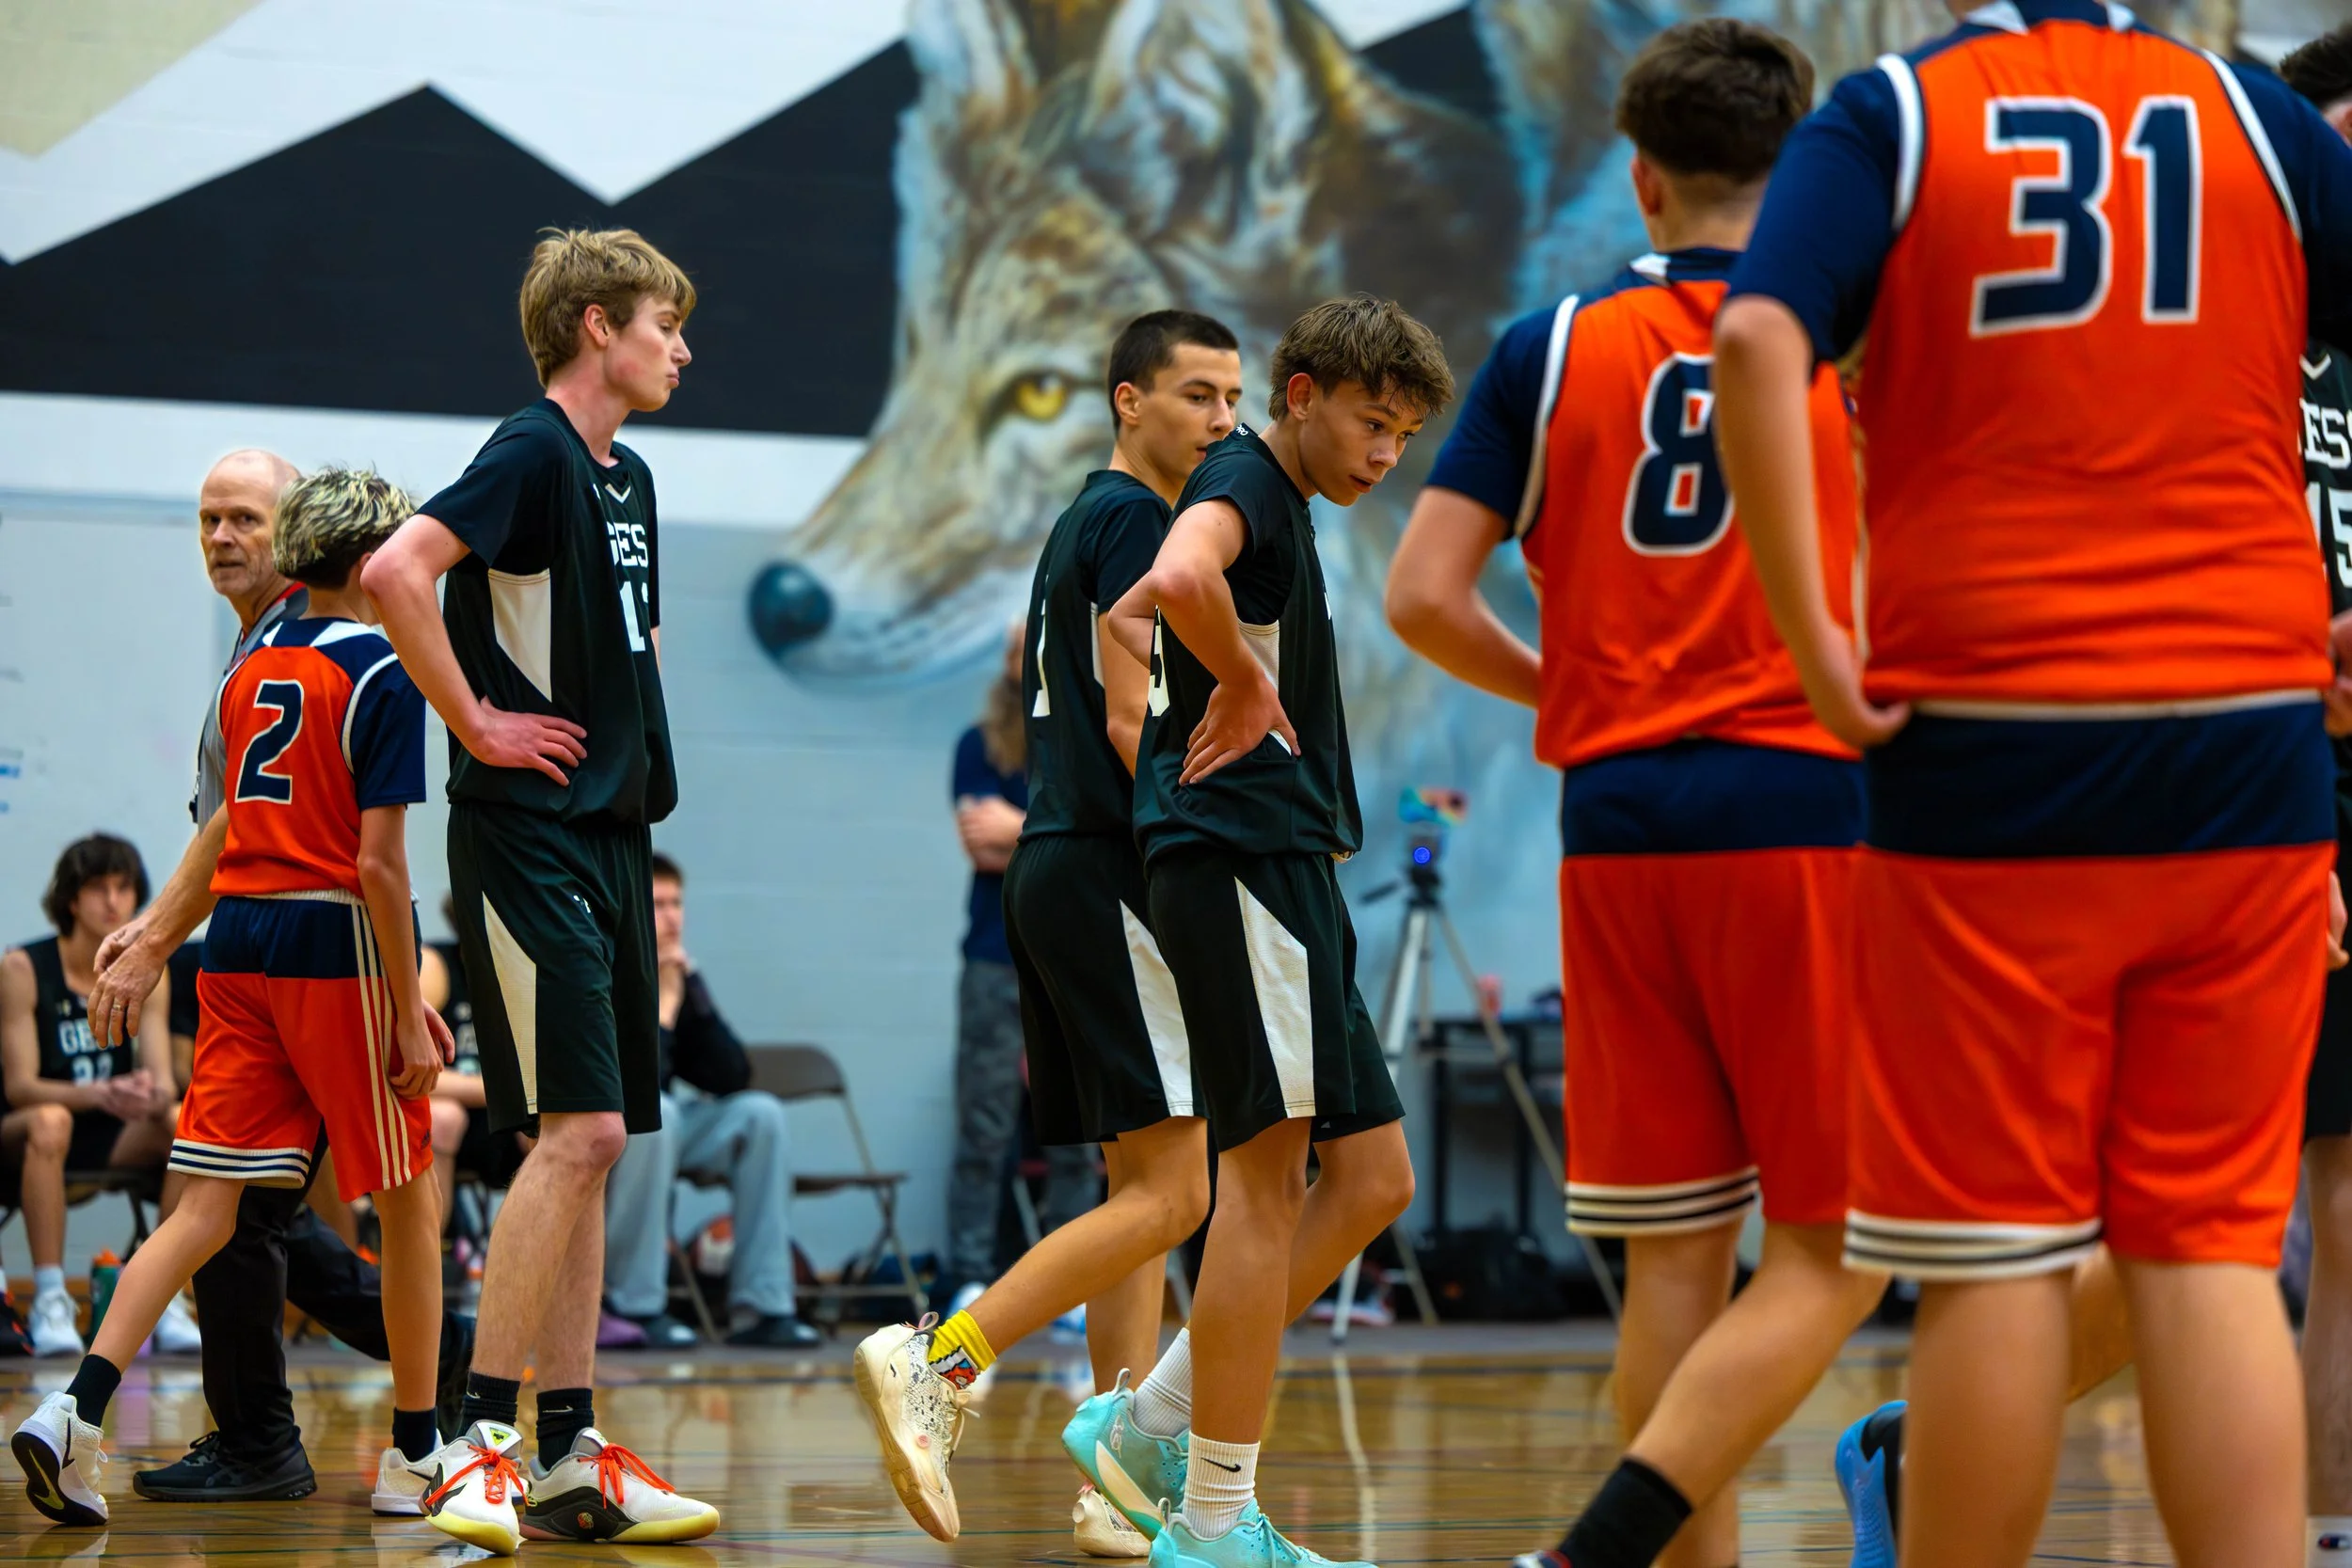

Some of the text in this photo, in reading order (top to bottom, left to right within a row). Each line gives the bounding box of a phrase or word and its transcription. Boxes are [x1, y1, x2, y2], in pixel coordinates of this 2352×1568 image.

[1968, 95, 2204, 340] 31
[1621, 351, 1736, 558] 8
[233, 678, 305, 806] 2
